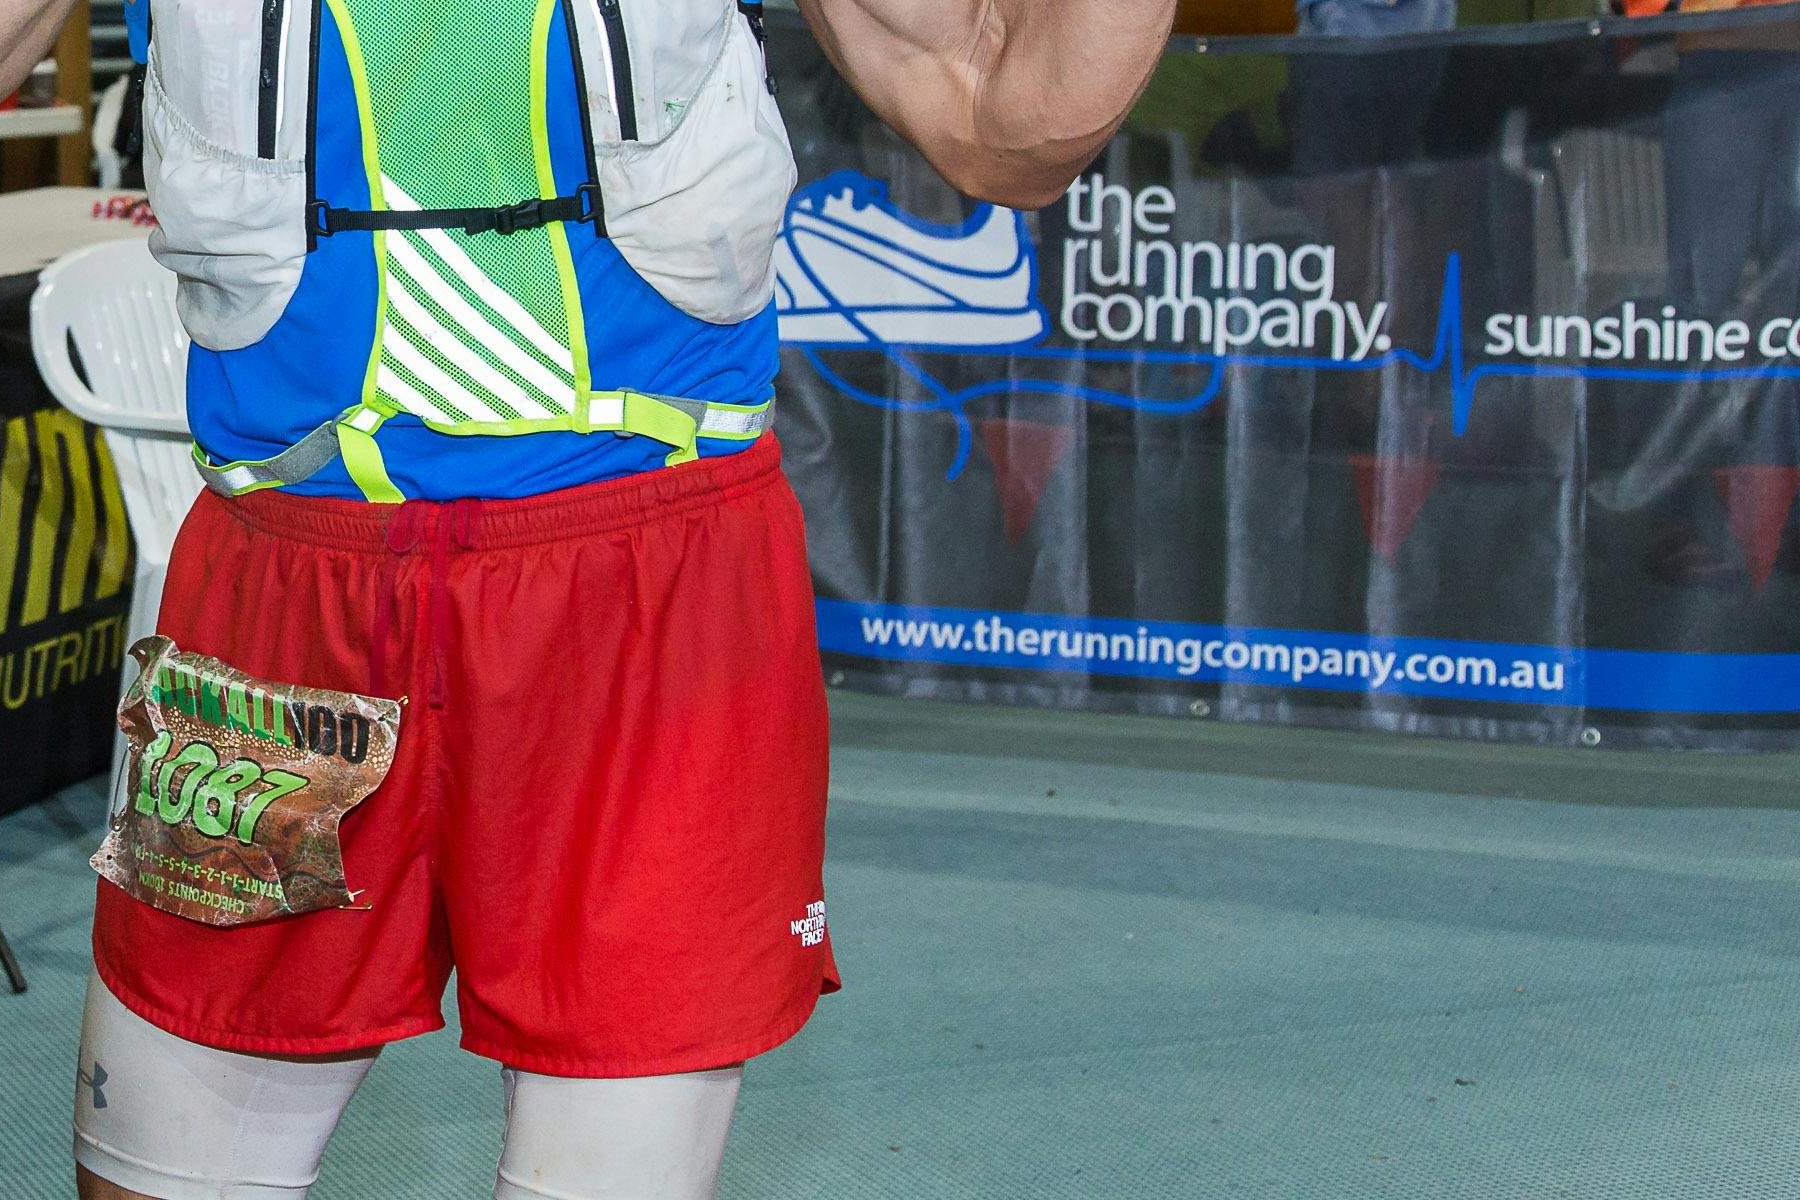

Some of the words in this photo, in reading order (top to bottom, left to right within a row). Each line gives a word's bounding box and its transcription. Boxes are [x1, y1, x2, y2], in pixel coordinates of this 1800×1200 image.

[1067, 172, 1177, 233] the
[1062, 236, 1336, 300] running
[1060, 292, 1392, 362] company.
[1484, 300, 1751, 363] sunshine
[861, 615, 1565, 691] www.therunningcompany.com.au
[134, 729, 312, 847] 1087
[167, 880, 246, 915] CHECKPOINTS
